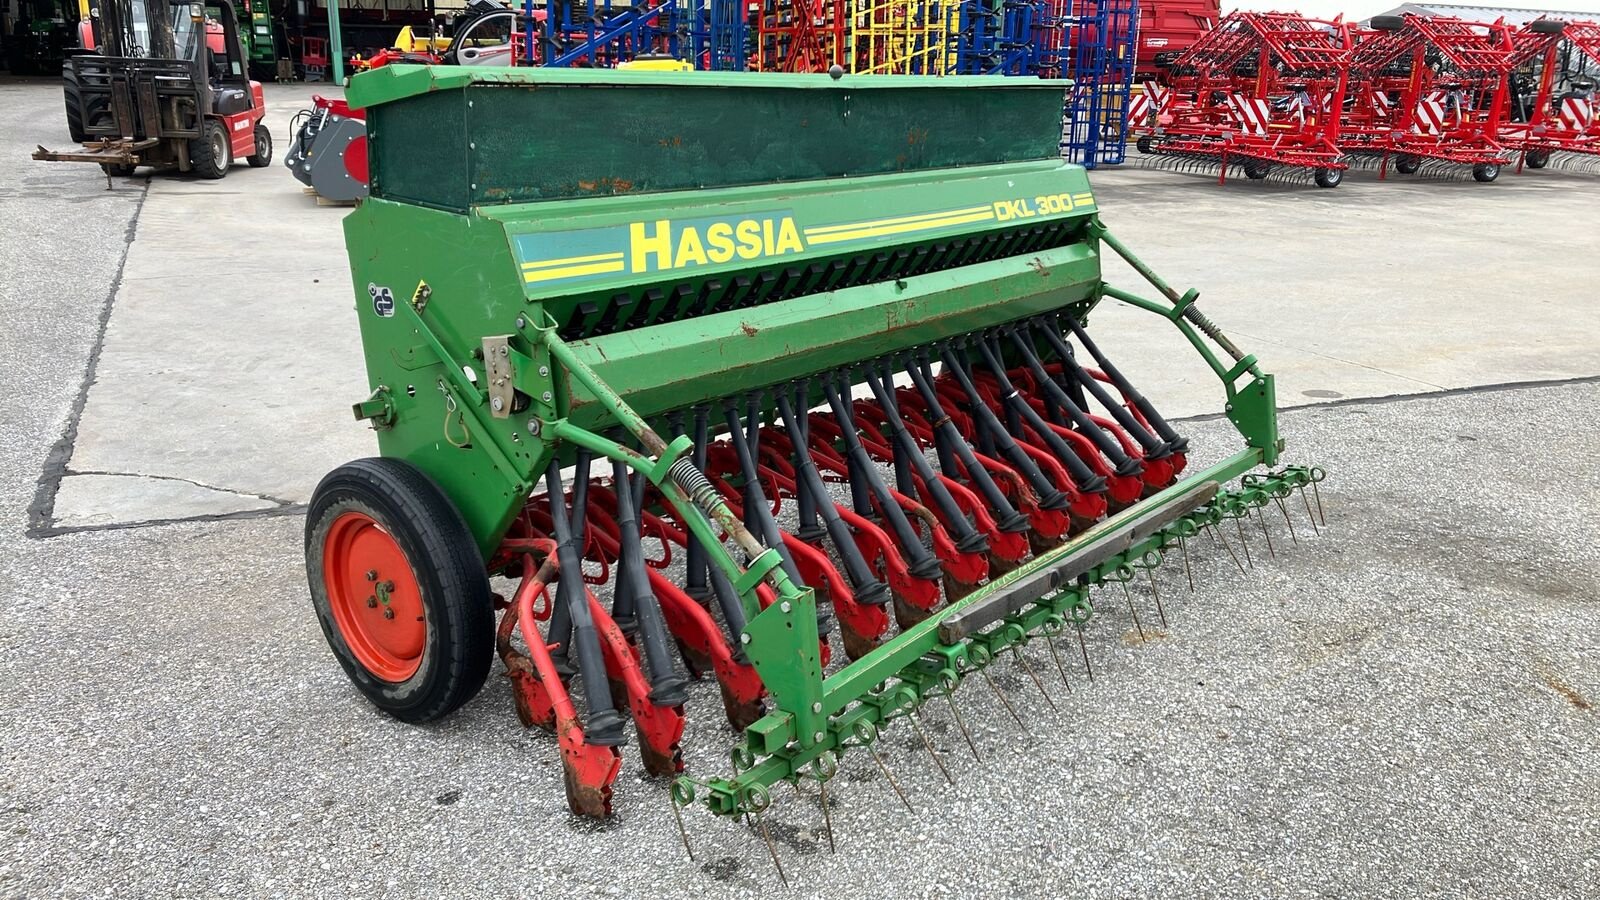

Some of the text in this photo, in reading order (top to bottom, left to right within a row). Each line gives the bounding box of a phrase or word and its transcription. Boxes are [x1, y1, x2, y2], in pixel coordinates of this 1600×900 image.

[993, 193, 1074, 221] DKL 300
[629, 216, 804, 274] HASSIA
